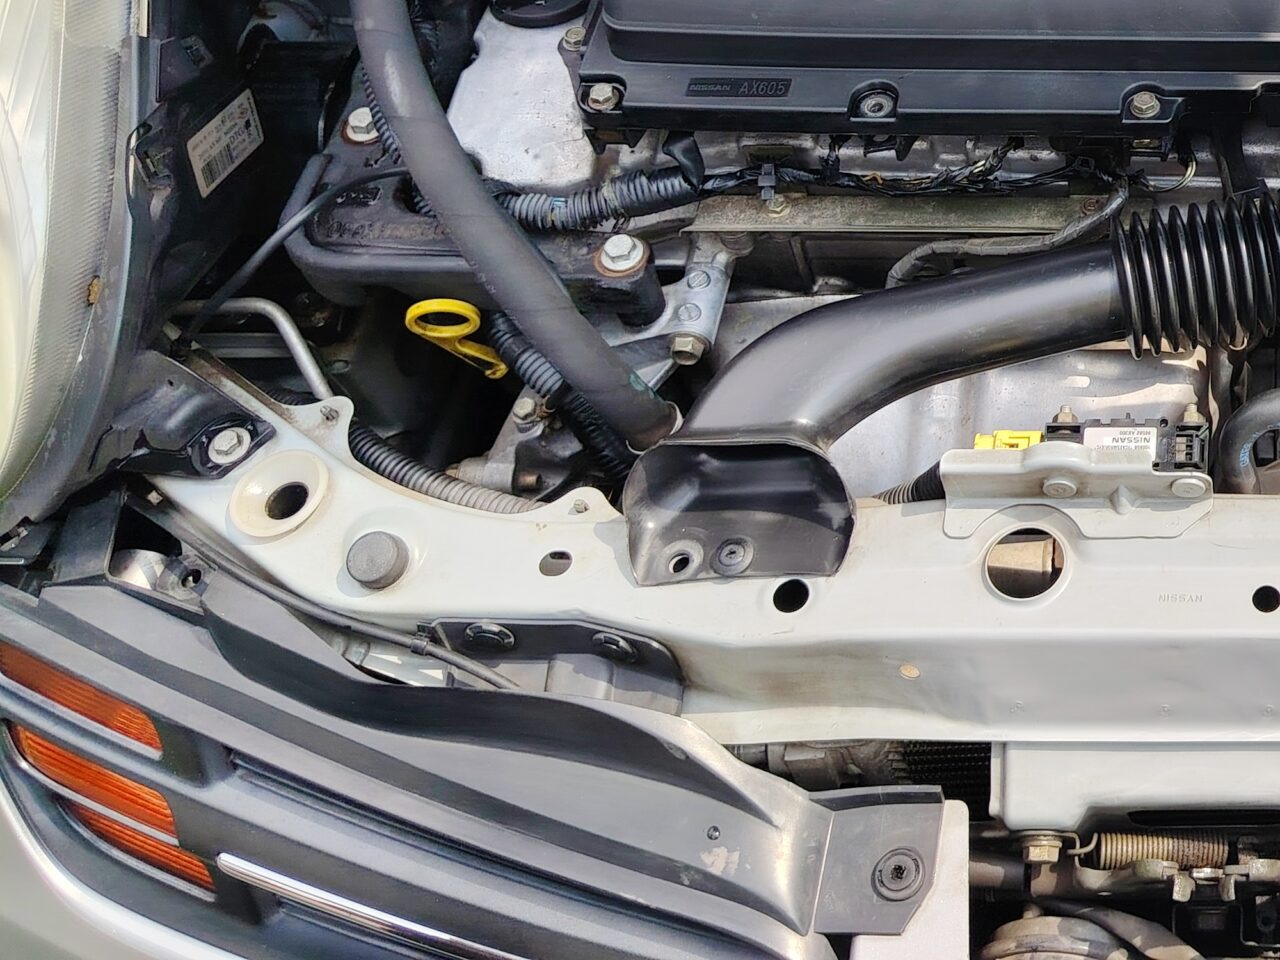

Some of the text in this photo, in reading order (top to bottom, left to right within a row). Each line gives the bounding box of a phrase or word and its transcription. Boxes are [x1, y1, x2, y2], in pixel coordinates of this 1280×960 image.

[689, 82, 786, 95] NISSAN AX605
[1111, 436, 1151, 444] NISSAN
[1158, 593, 1204, 602] NISSAN
